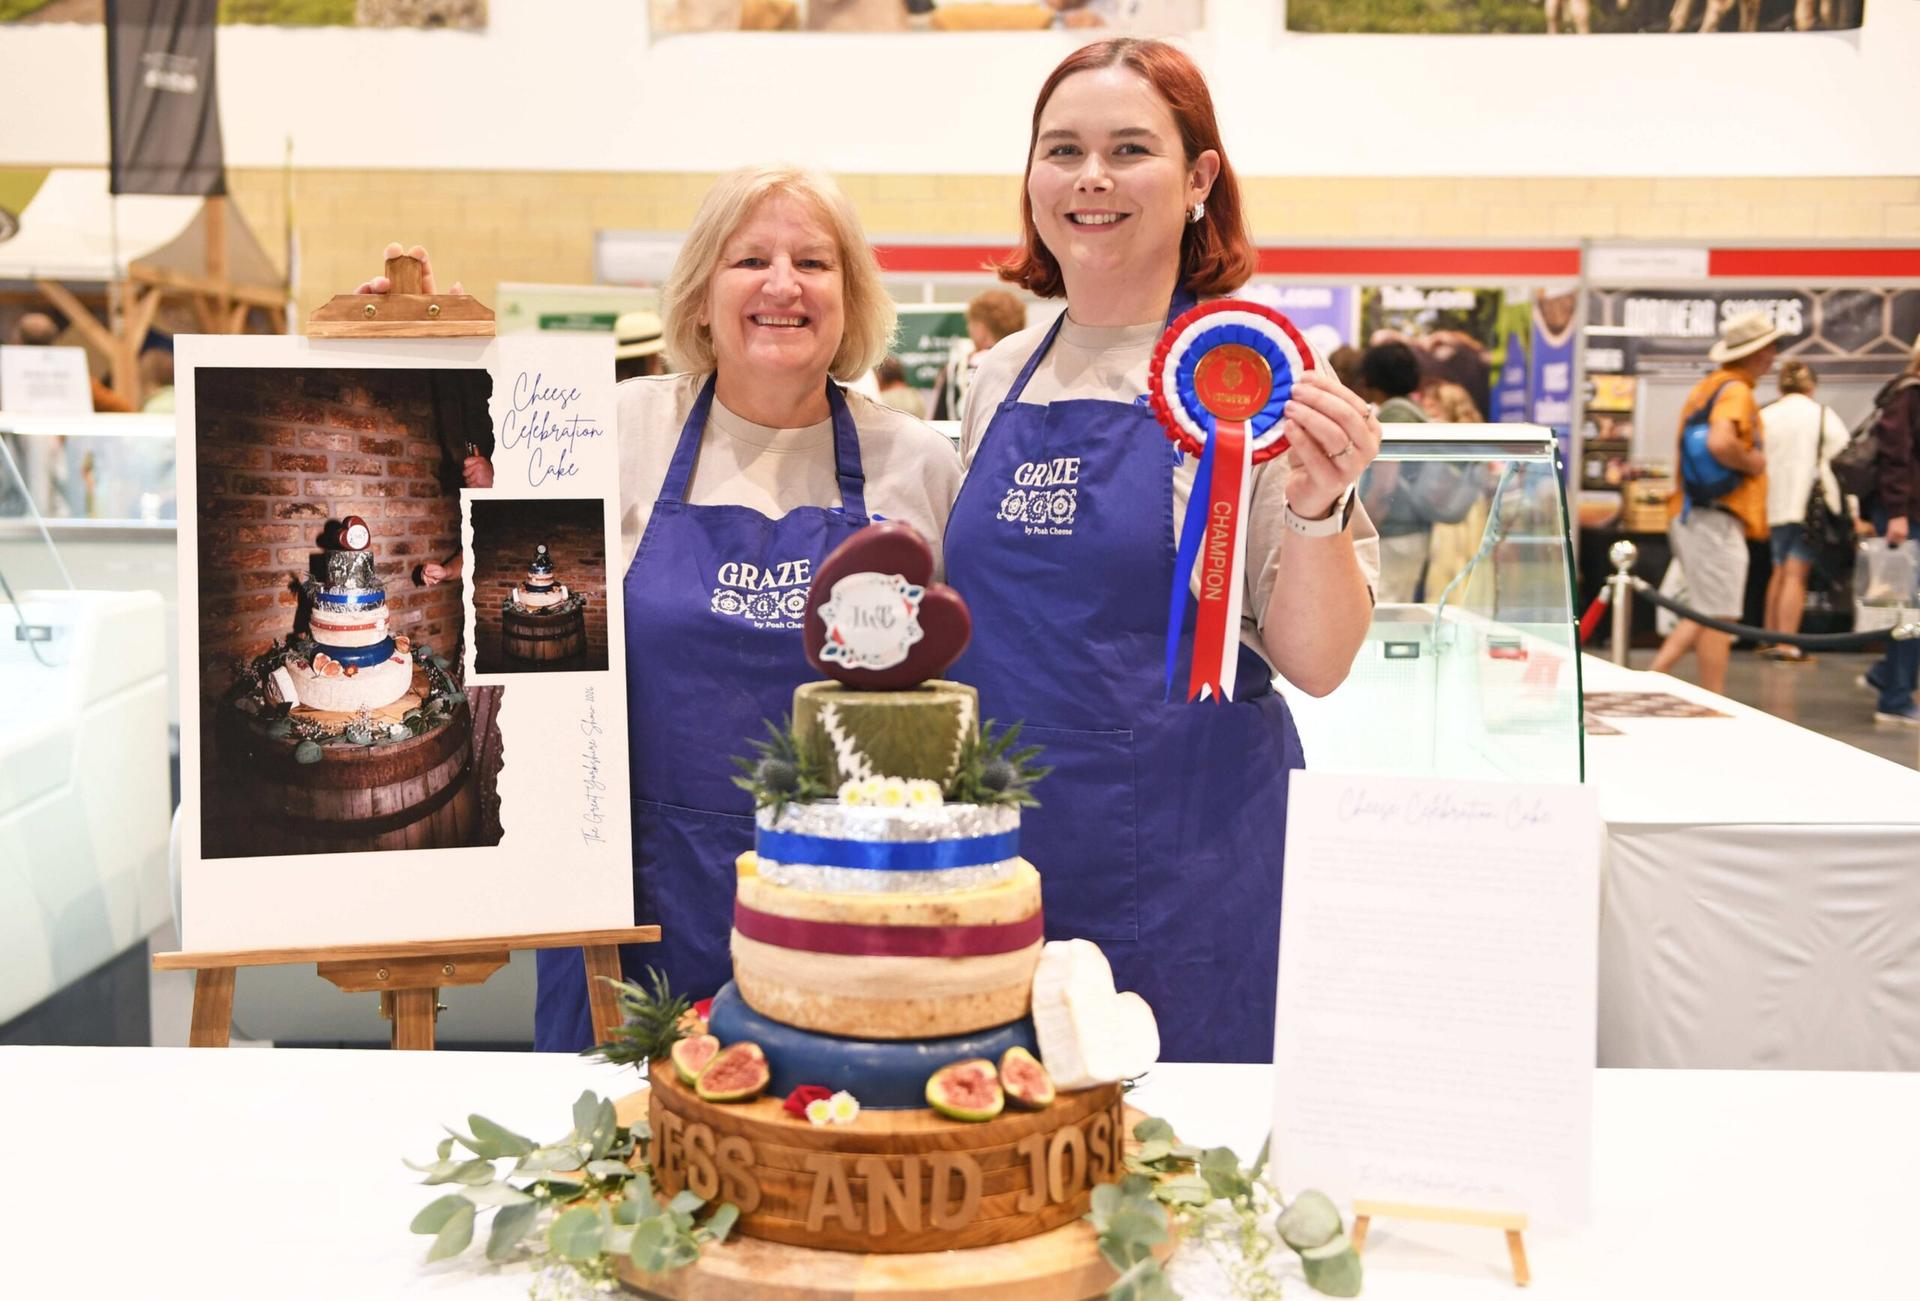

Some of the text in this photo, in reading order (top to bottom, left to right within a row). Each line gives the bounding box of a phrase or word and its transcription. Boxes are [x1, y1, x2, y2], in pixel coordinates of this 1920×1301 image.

[513, 372, 581, 412] Cheese
[501, 409, 604, 453] Celebration
[528, 447, 579, 487] Cake
[1014, 457, 1081, 488] GRAZE
[1024, 526, 1033, 536] by
[1034, 526, 1048, 535] Posh
[1205, 501, 1232, 601] CHAMPION
[717, 559, 812, 591] GRAZE
[754, 621, 764, 630] by
[766, 621, 785, 629] Posh
[583, 787, 606, 822] Great
[580, 826, 606, 847] The
[806, 1149, 984, 1237] AND
